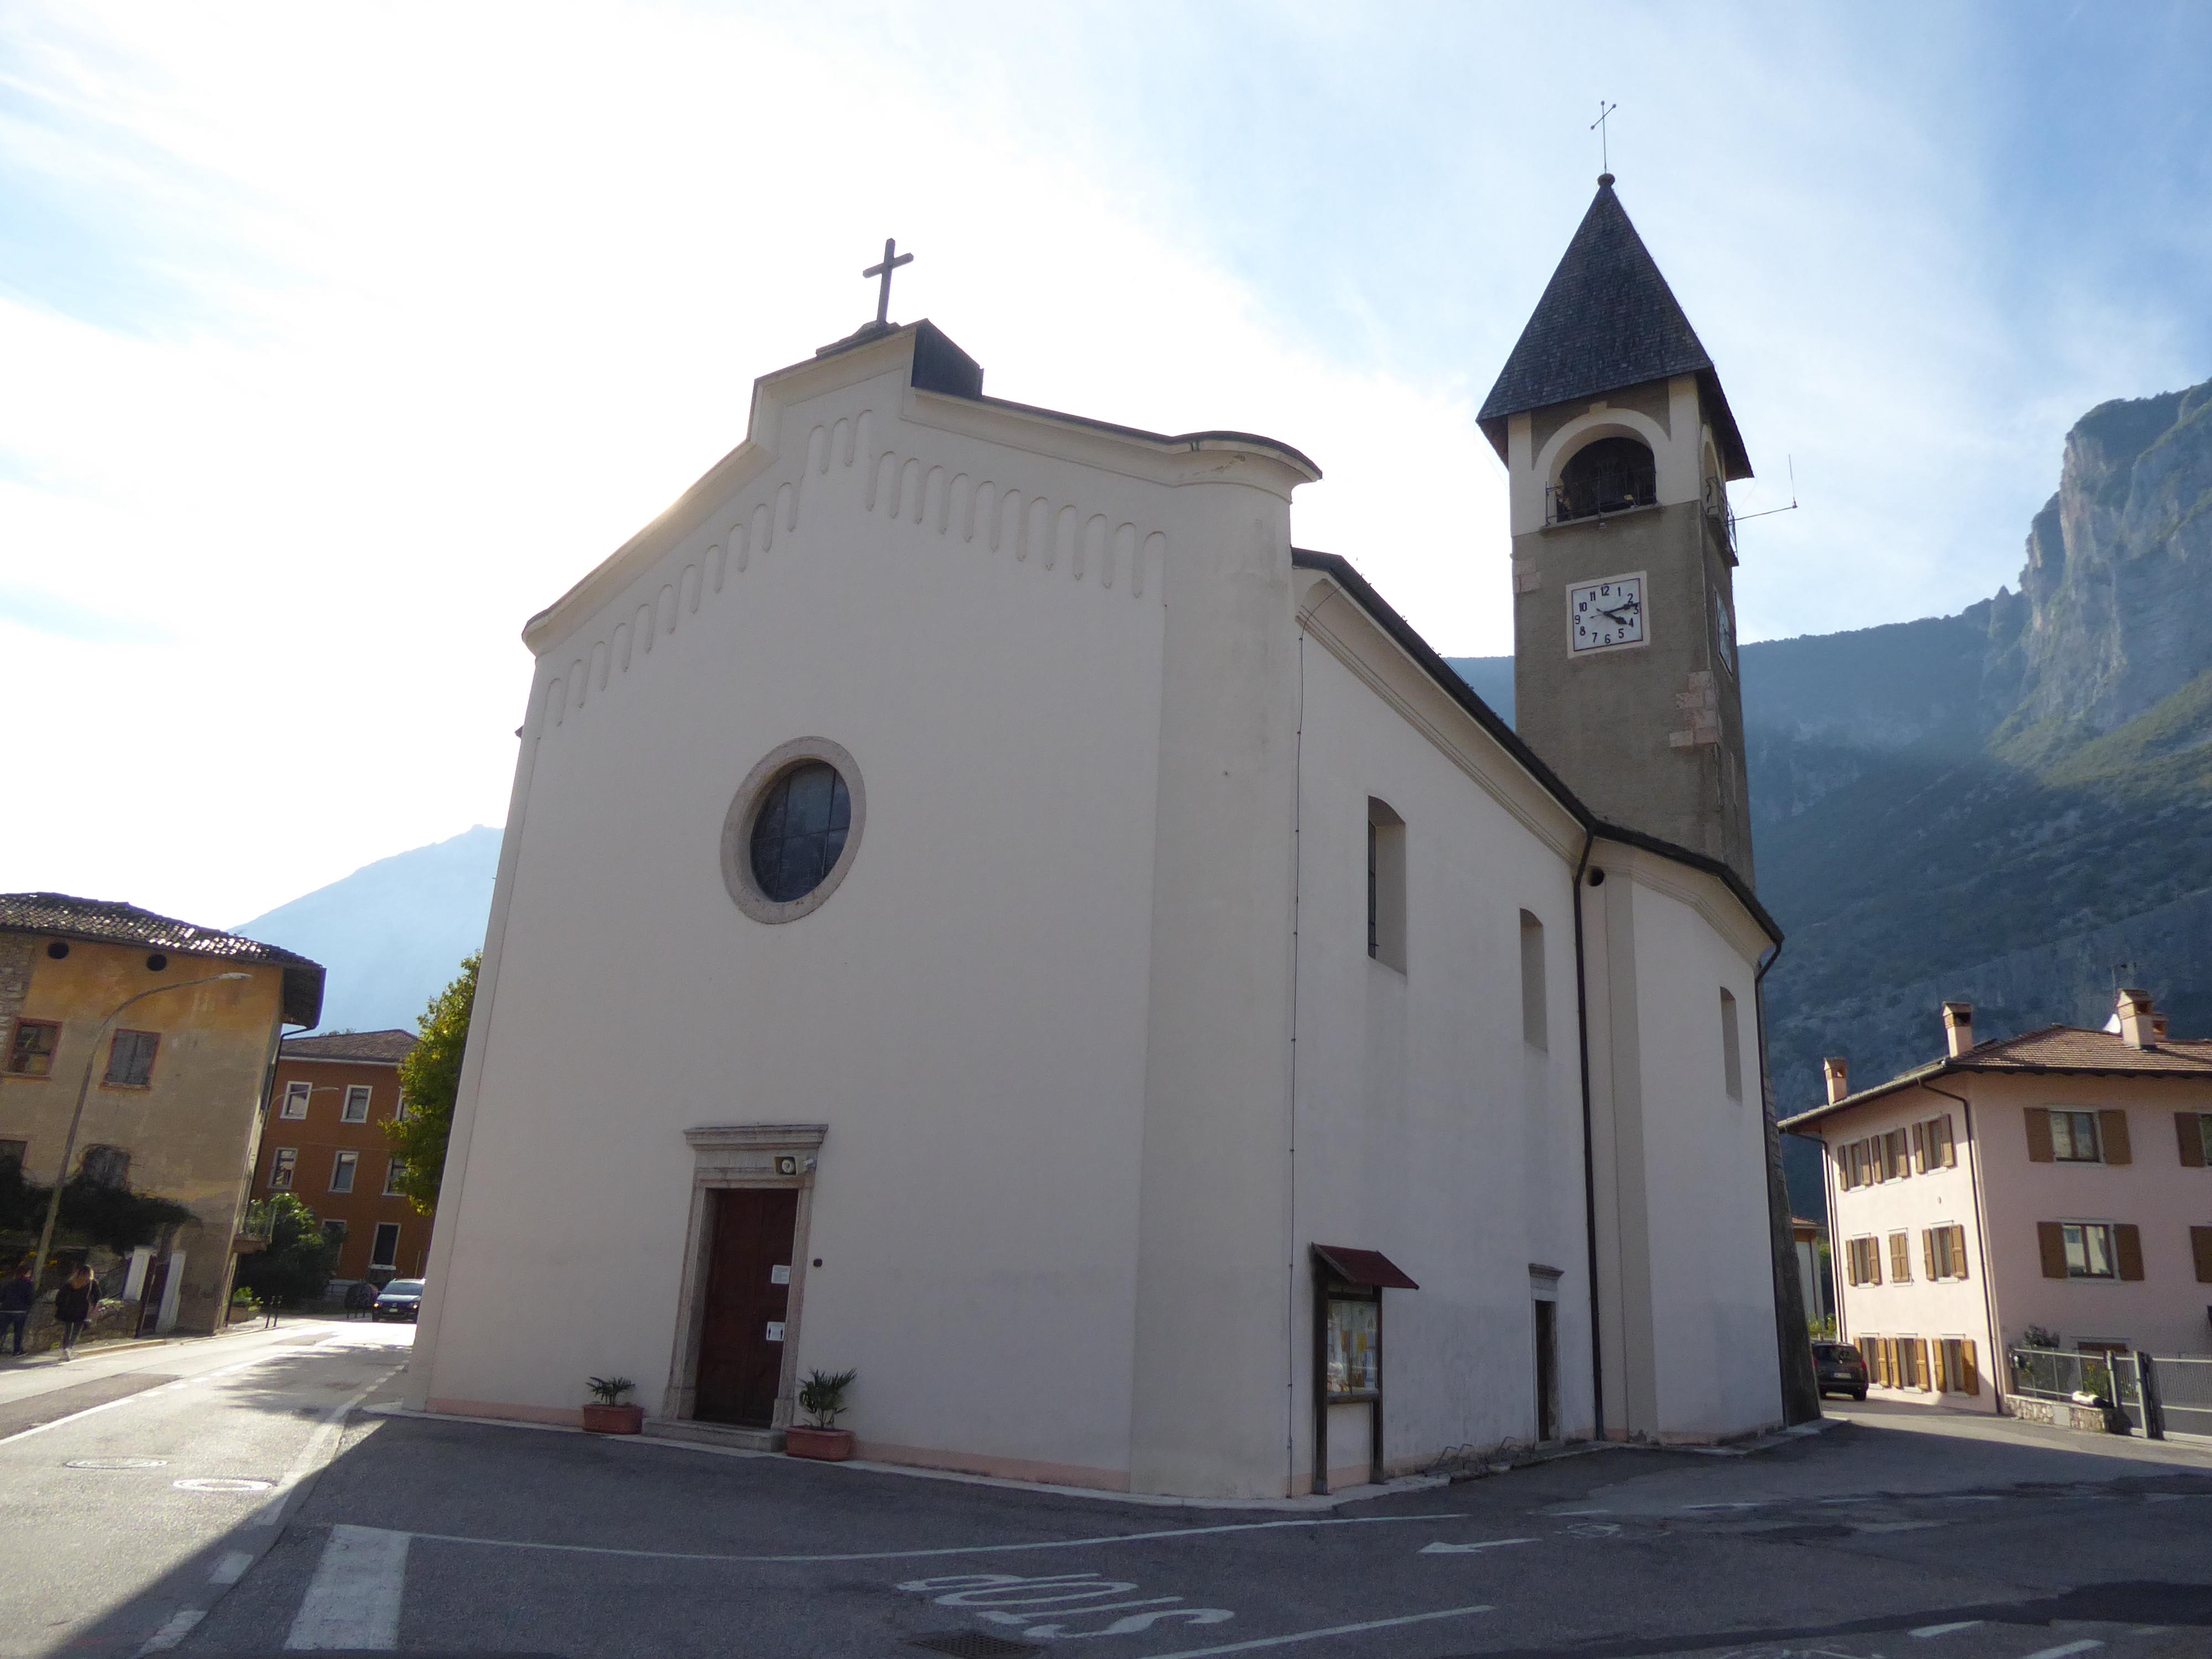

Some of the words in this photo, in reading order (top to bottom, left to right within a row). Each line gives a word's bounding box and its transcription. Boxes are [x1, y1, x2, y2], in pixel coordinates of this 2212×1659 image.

[1590, 591, 1596, 601] 11
[1600, 586, 1610, 596] 12
[1618, 587, 1621, 596] 1
[1627, 593, 1634, 604] 2
[1579, 602, 1587, 612] 10
[1574, 615, 1581, 624] 9
[1629, 618, 1634, 628] 4
[1579, 626, 1586, 636] 8
[1618, 628, 1624, 639] 5
[1592, 632, 1598, 643] 7
[1604, 634, 1611, 644] 6
[896, 1572, 1235, 1639] STOP
